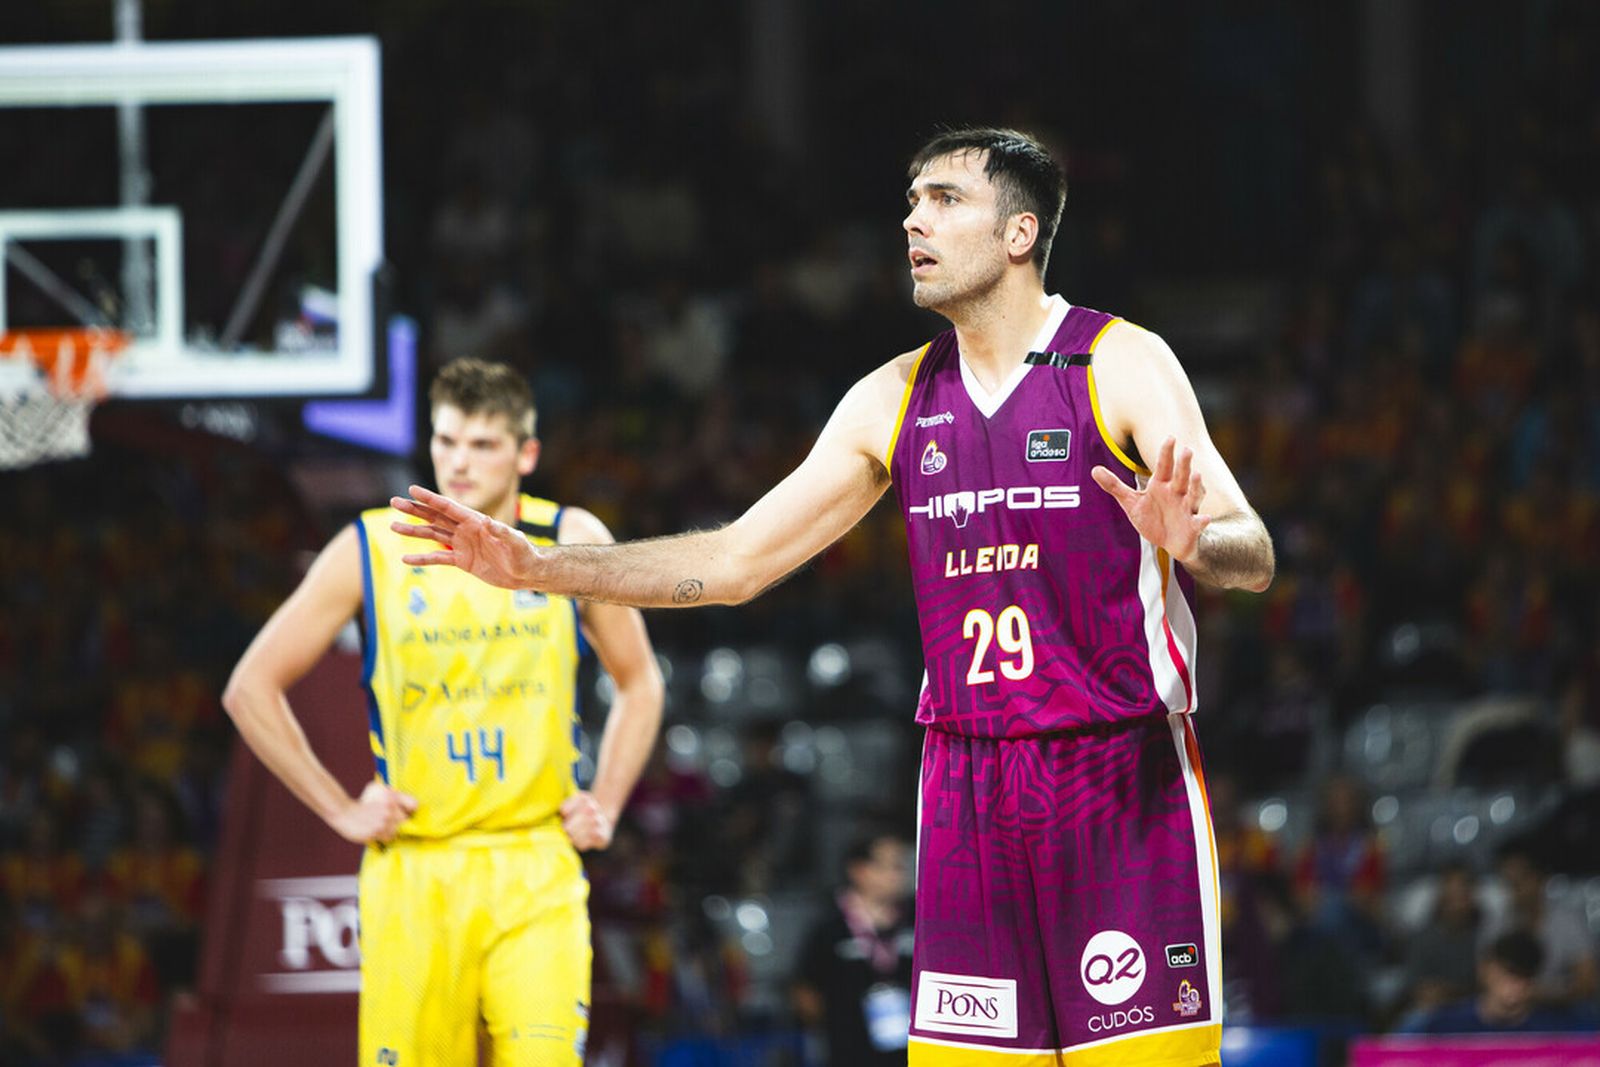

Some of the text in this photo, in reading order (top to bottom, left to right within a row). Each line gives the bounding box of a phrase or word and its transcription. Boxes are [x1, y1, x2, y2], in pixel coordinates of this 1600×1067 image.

[945, 543, 1039, 578] LLEIDA
[963, 604, 1035, 685] 29
[447, 726, 504, 783] 44
[281, 896, 359, 969] PO
[1084, 947, 1144, 987] Q2
[1171, 953, 1192, 964] acb
[935, 988, 998, 1020] PONS
[1087, 1005, 1155, 1033] CUDÓS
